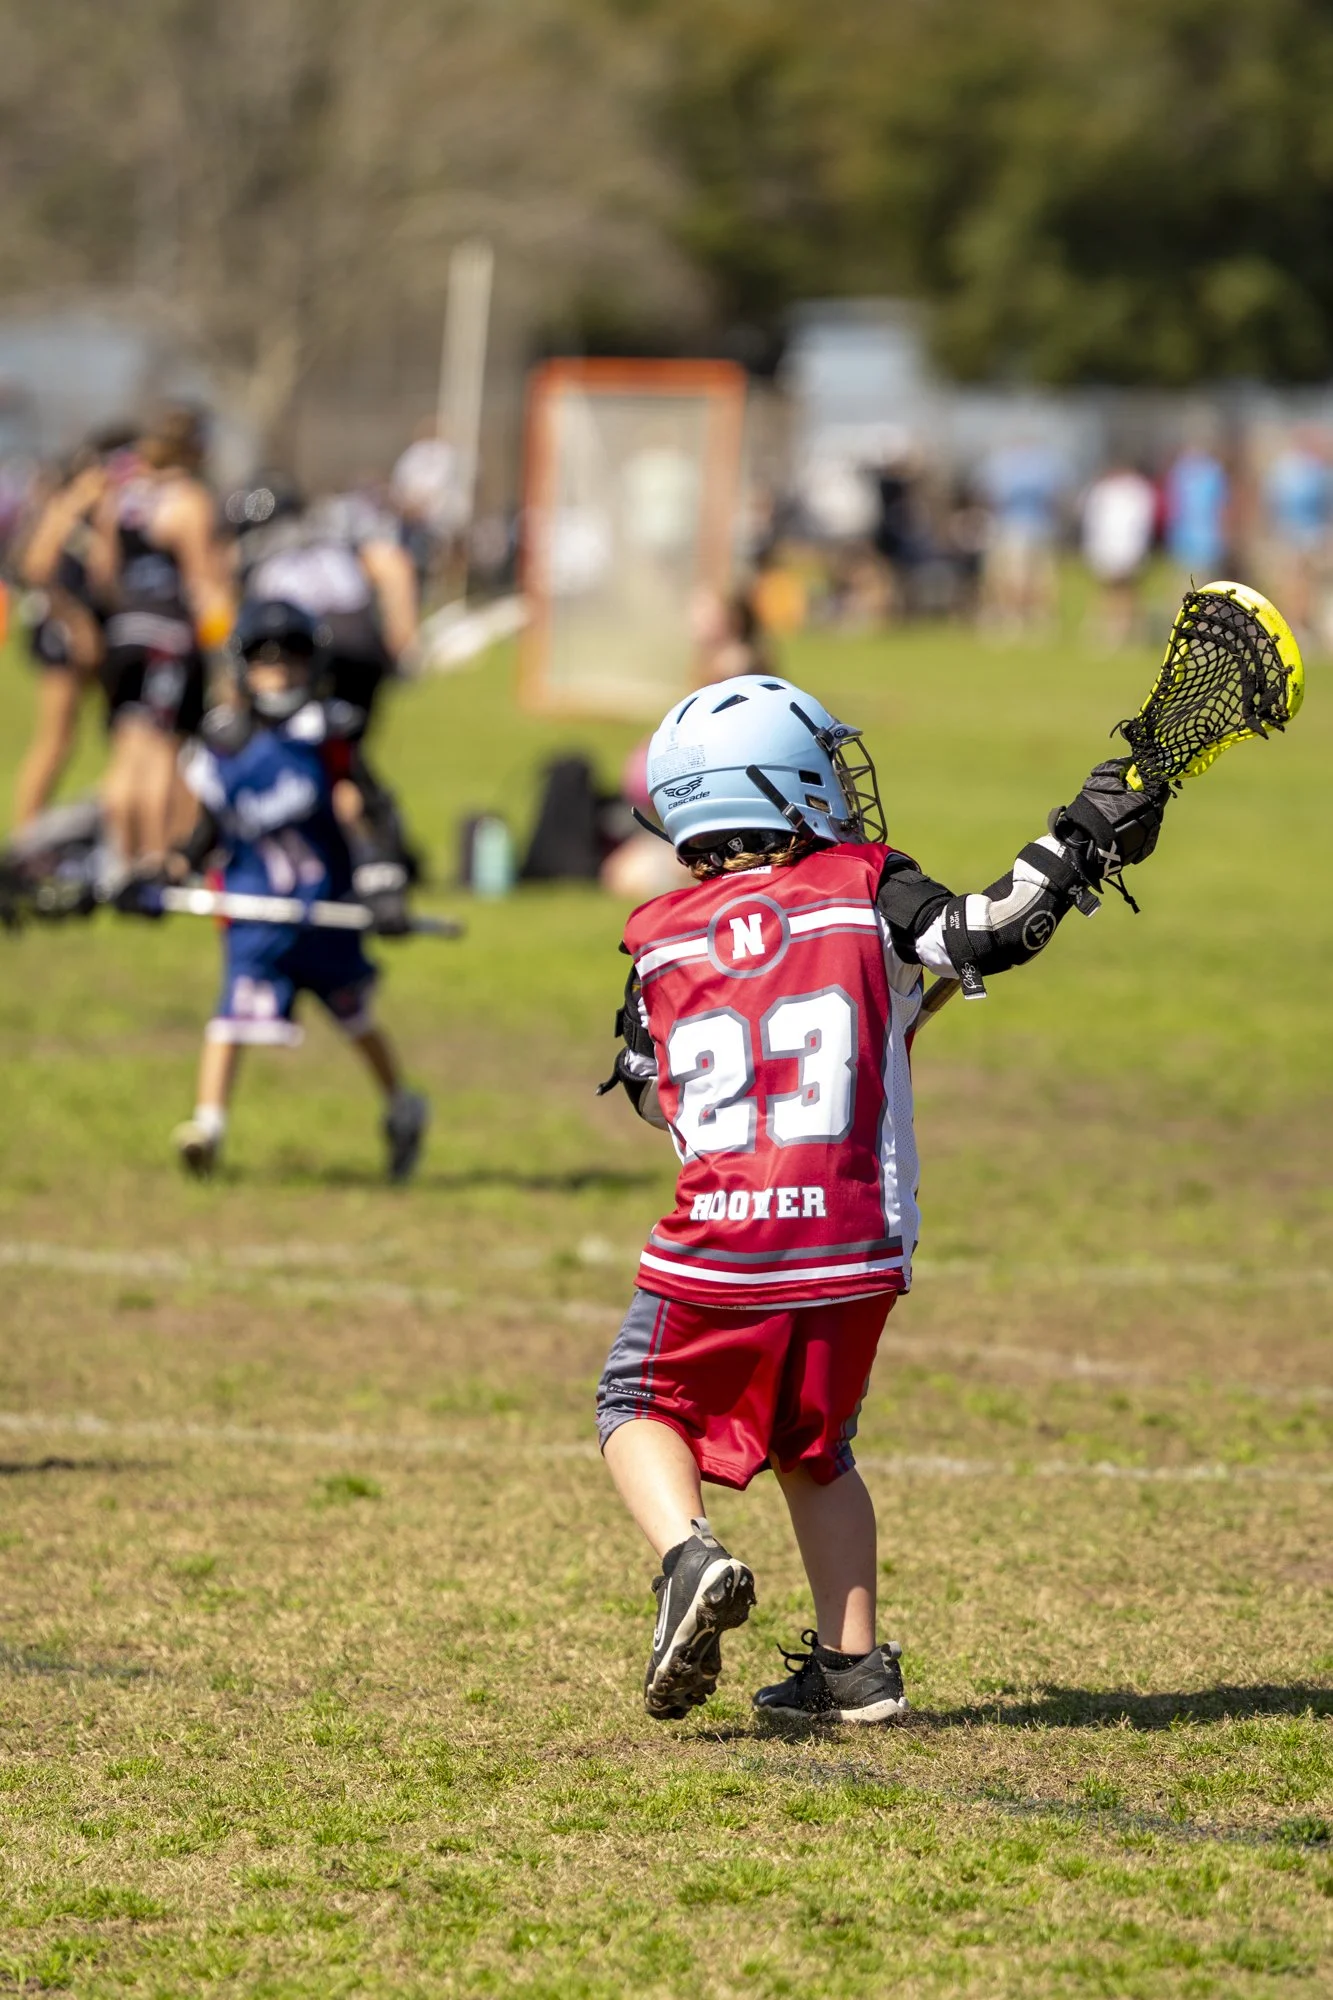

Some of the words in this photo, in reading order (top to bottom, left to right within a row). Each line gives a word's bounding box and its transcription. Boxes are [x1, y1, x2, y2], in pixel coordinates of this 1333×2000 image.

[667, 791, 710, 810] cascade
[729, 912, 766, 960] N
[665, 984, 858, 1161] 23
[608, 1386, 651, 1398] SIGNATURE
